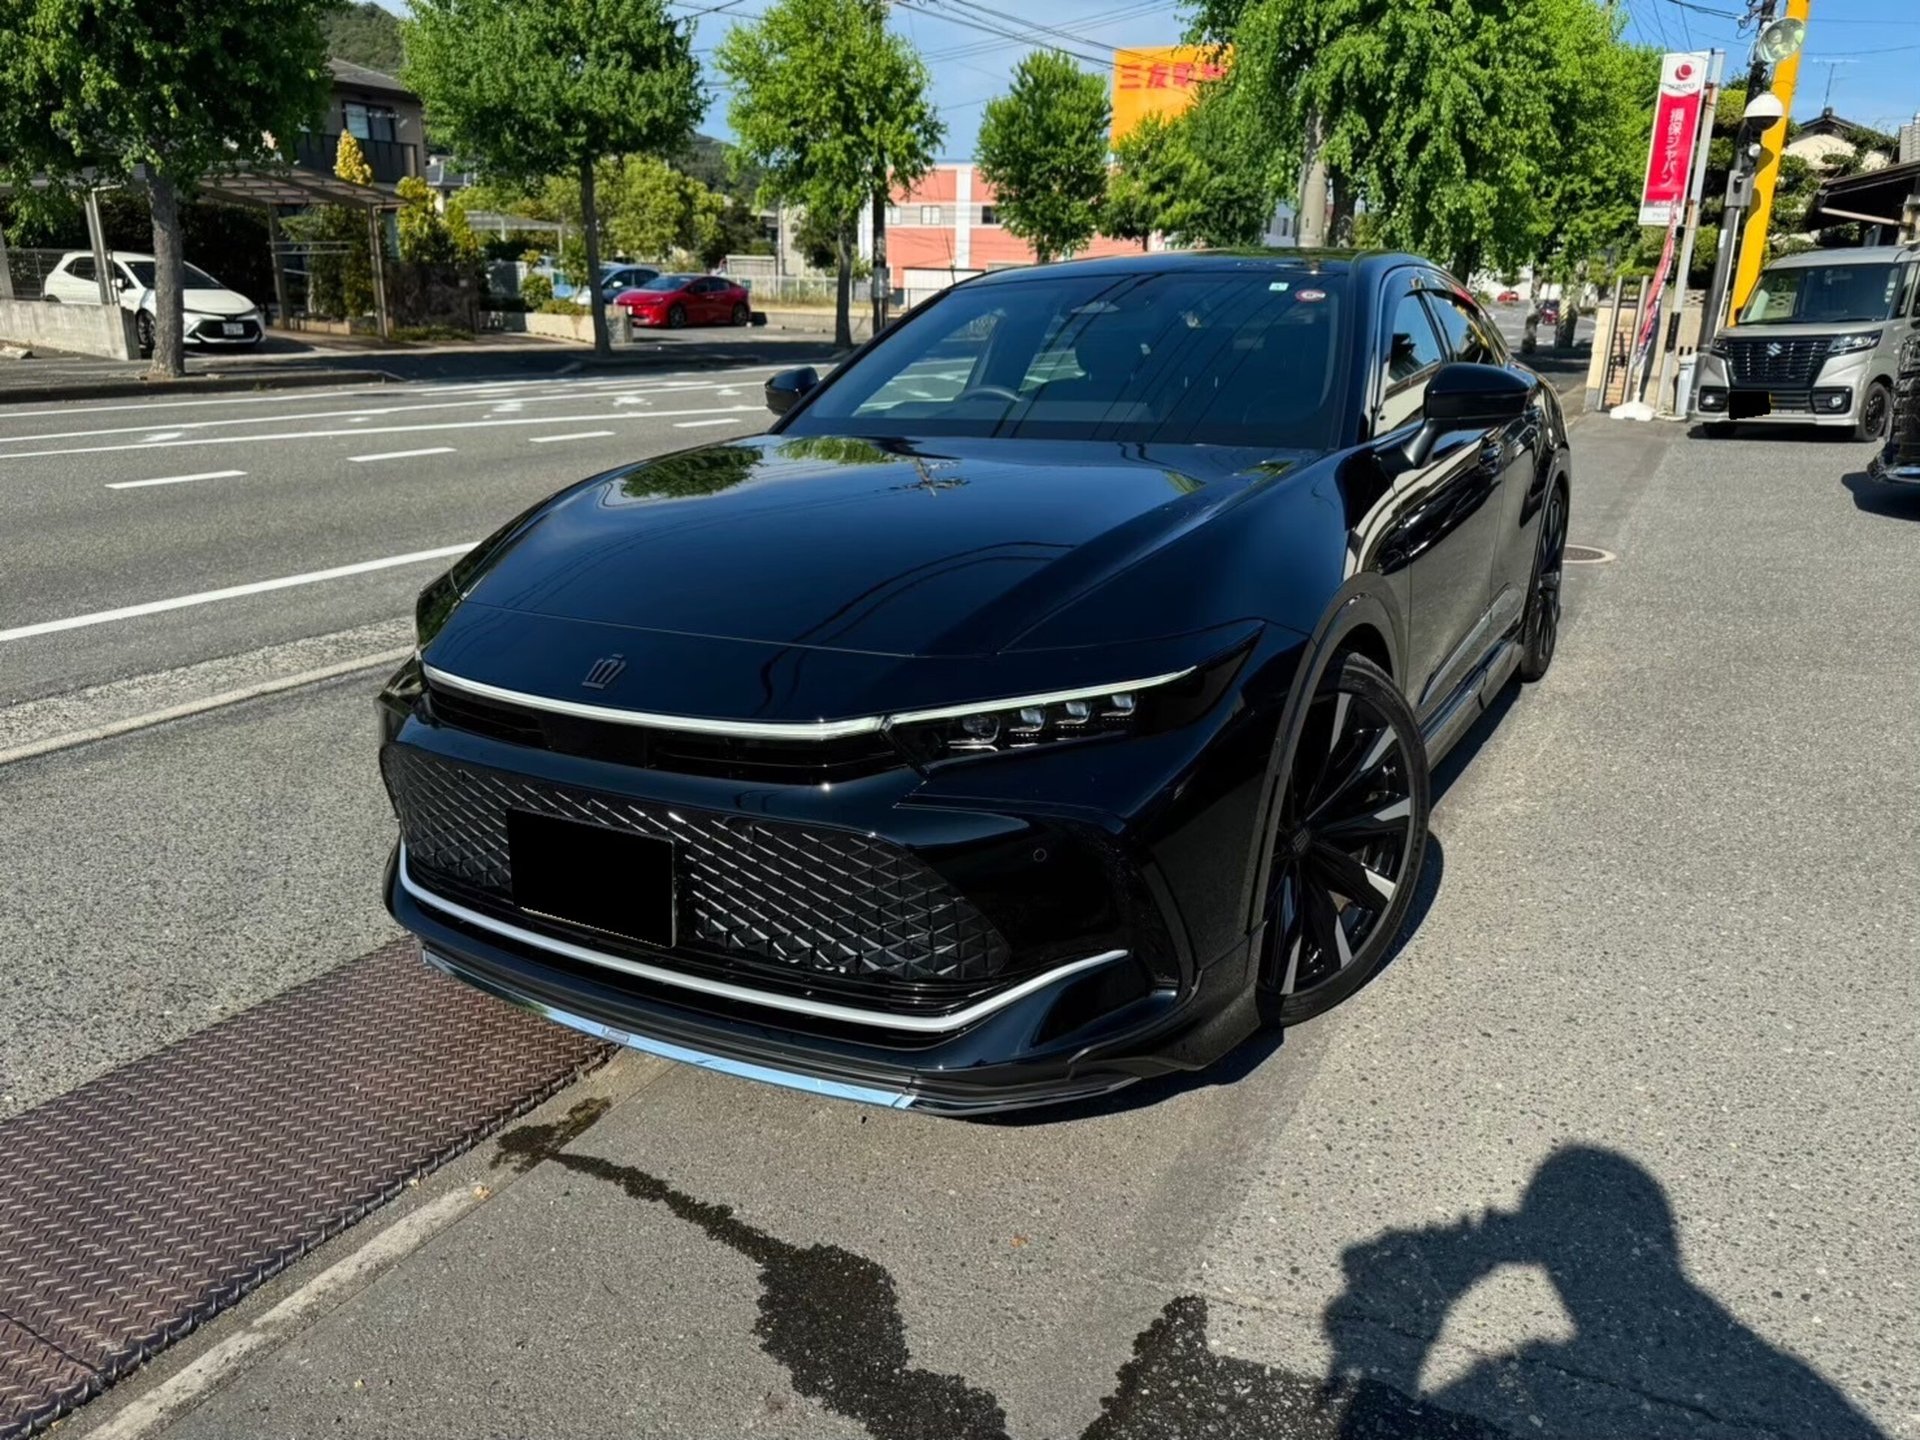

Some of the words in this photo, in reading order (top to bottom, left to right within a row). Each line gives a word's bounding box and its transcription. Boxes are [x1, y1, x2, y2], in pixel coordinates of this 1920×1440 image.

[1660, 107, 1685, 188] 損保ジャパン
